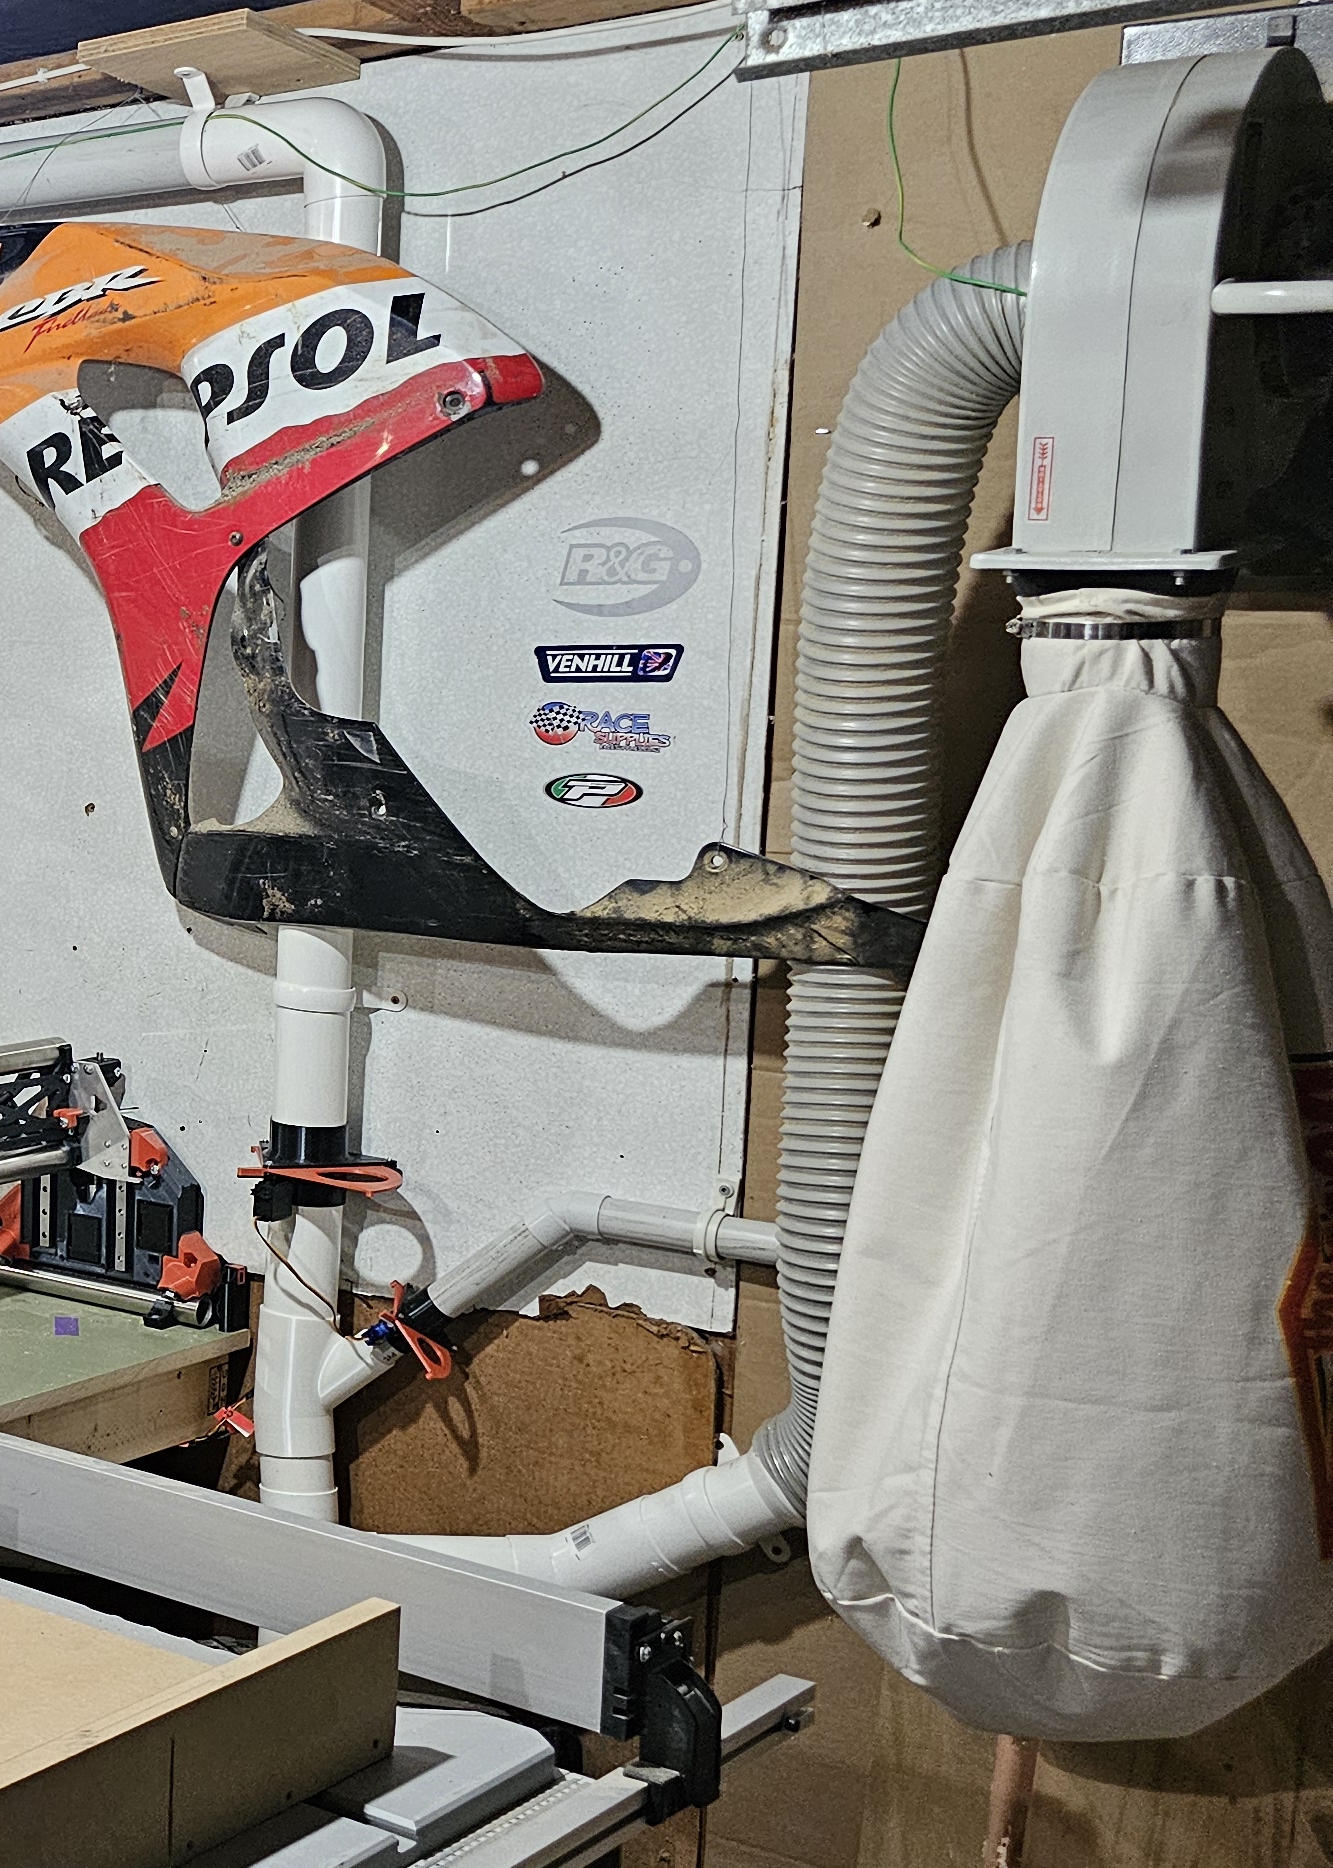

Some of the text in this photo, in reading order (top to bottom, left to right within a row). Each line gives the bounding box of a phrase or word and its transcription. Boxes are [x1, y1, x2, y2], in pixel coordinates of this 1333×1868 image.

[559, 541, 674, 586] R&G
[546, 654, 633, 672] VENHILL
[579, 711, 650, 734] RACE
[594, 732, 671, 748] SUPPLIES
